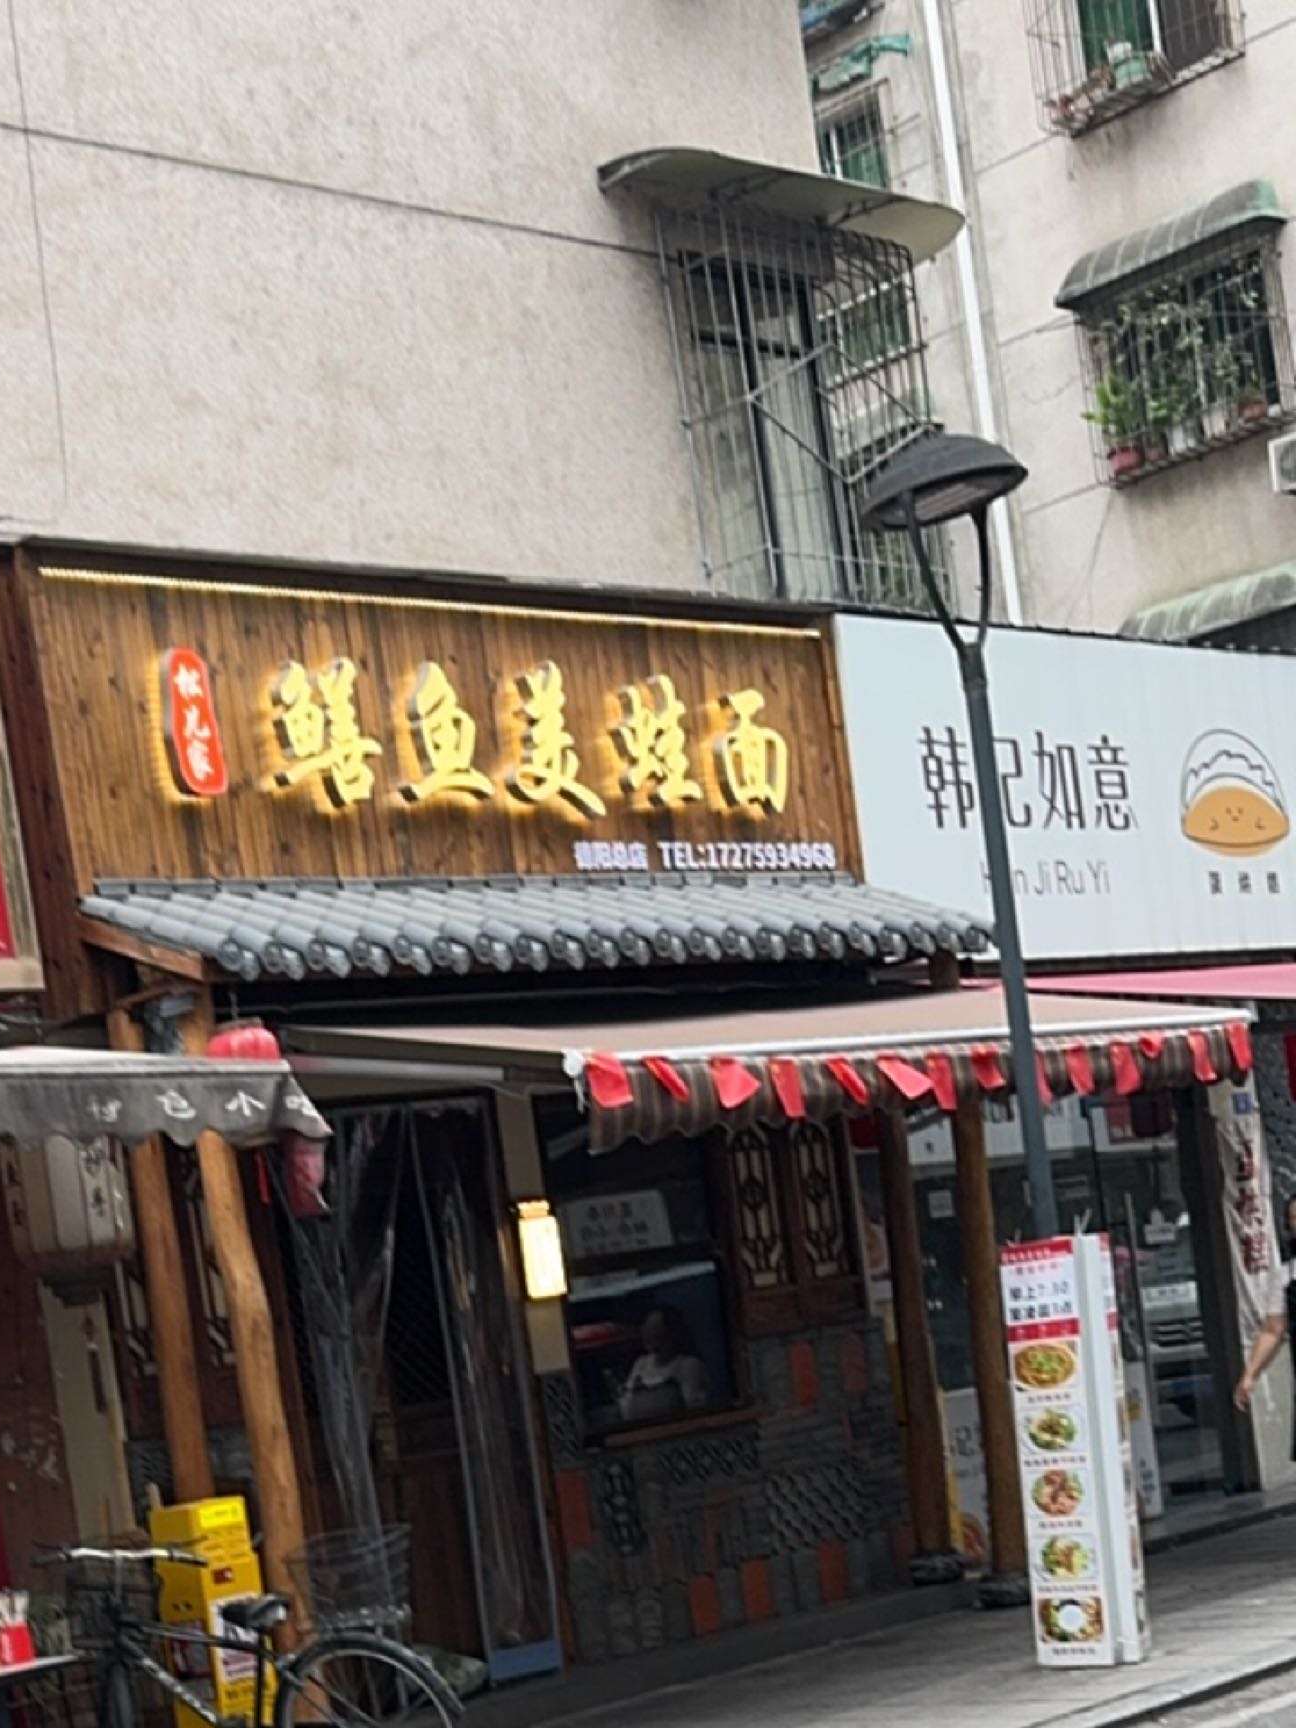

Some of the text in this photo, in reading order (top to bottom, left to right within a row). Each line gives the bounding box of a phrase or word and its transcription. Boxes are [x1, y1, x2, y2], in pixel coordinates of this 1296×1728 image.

[269, 655, 789, 819] 鳝鱼美蛙面
